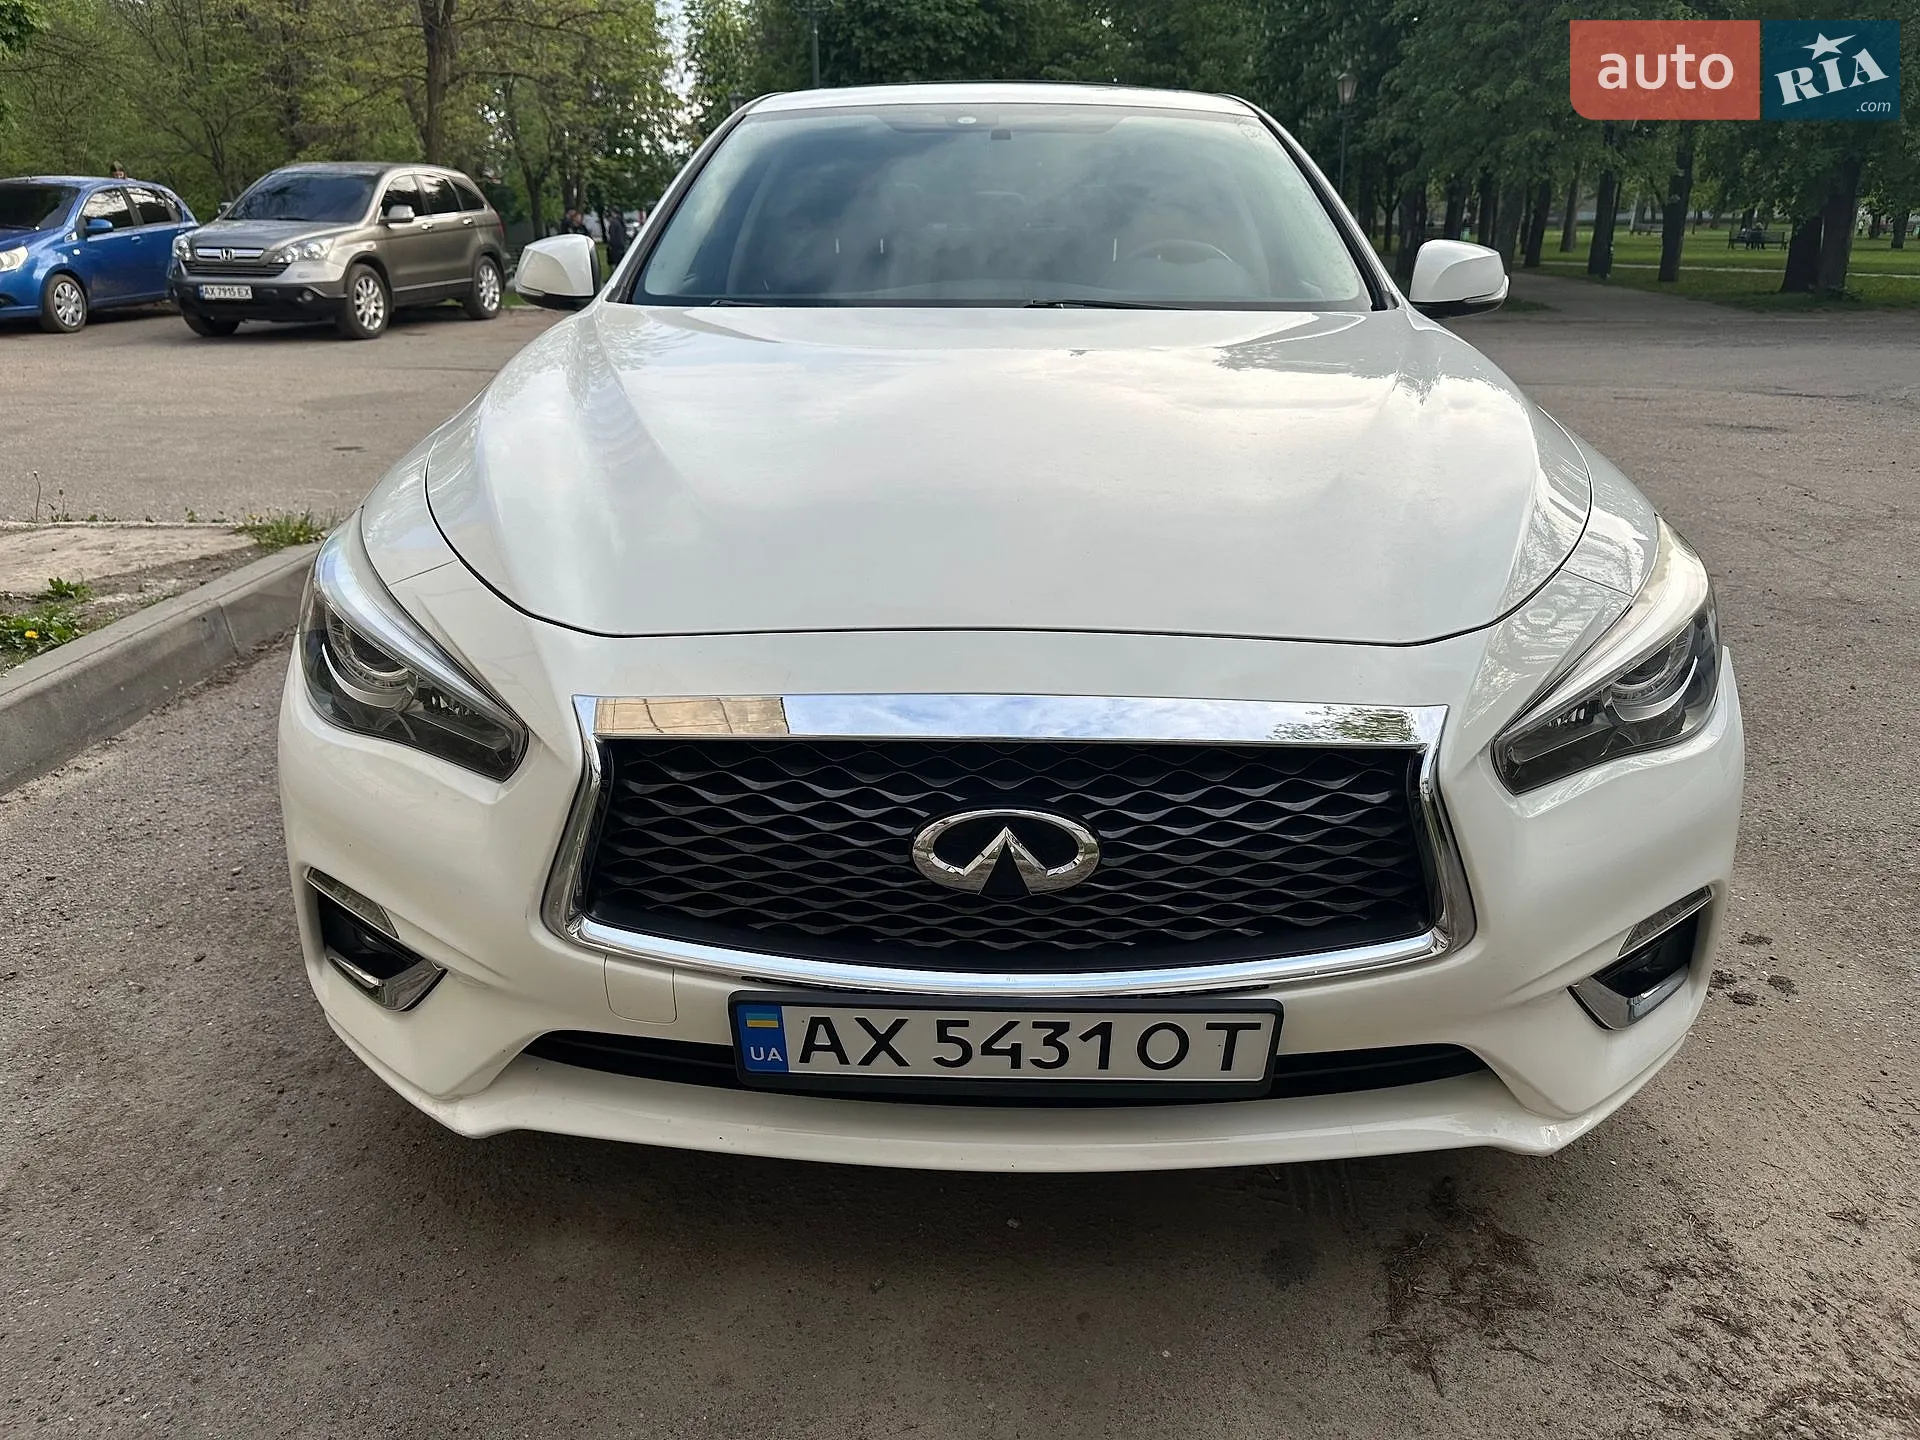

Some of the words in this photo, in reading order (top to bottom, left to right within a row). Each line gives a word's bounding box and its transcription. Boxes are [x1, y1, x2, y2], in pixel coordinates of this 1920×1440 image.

[749, 1046, 782, 1062] UA
[799, 1016, 911, 1067] AX
[932, 1019, 1113, 1070] 5431
[1136, 1021, 1262, 1072] OT
